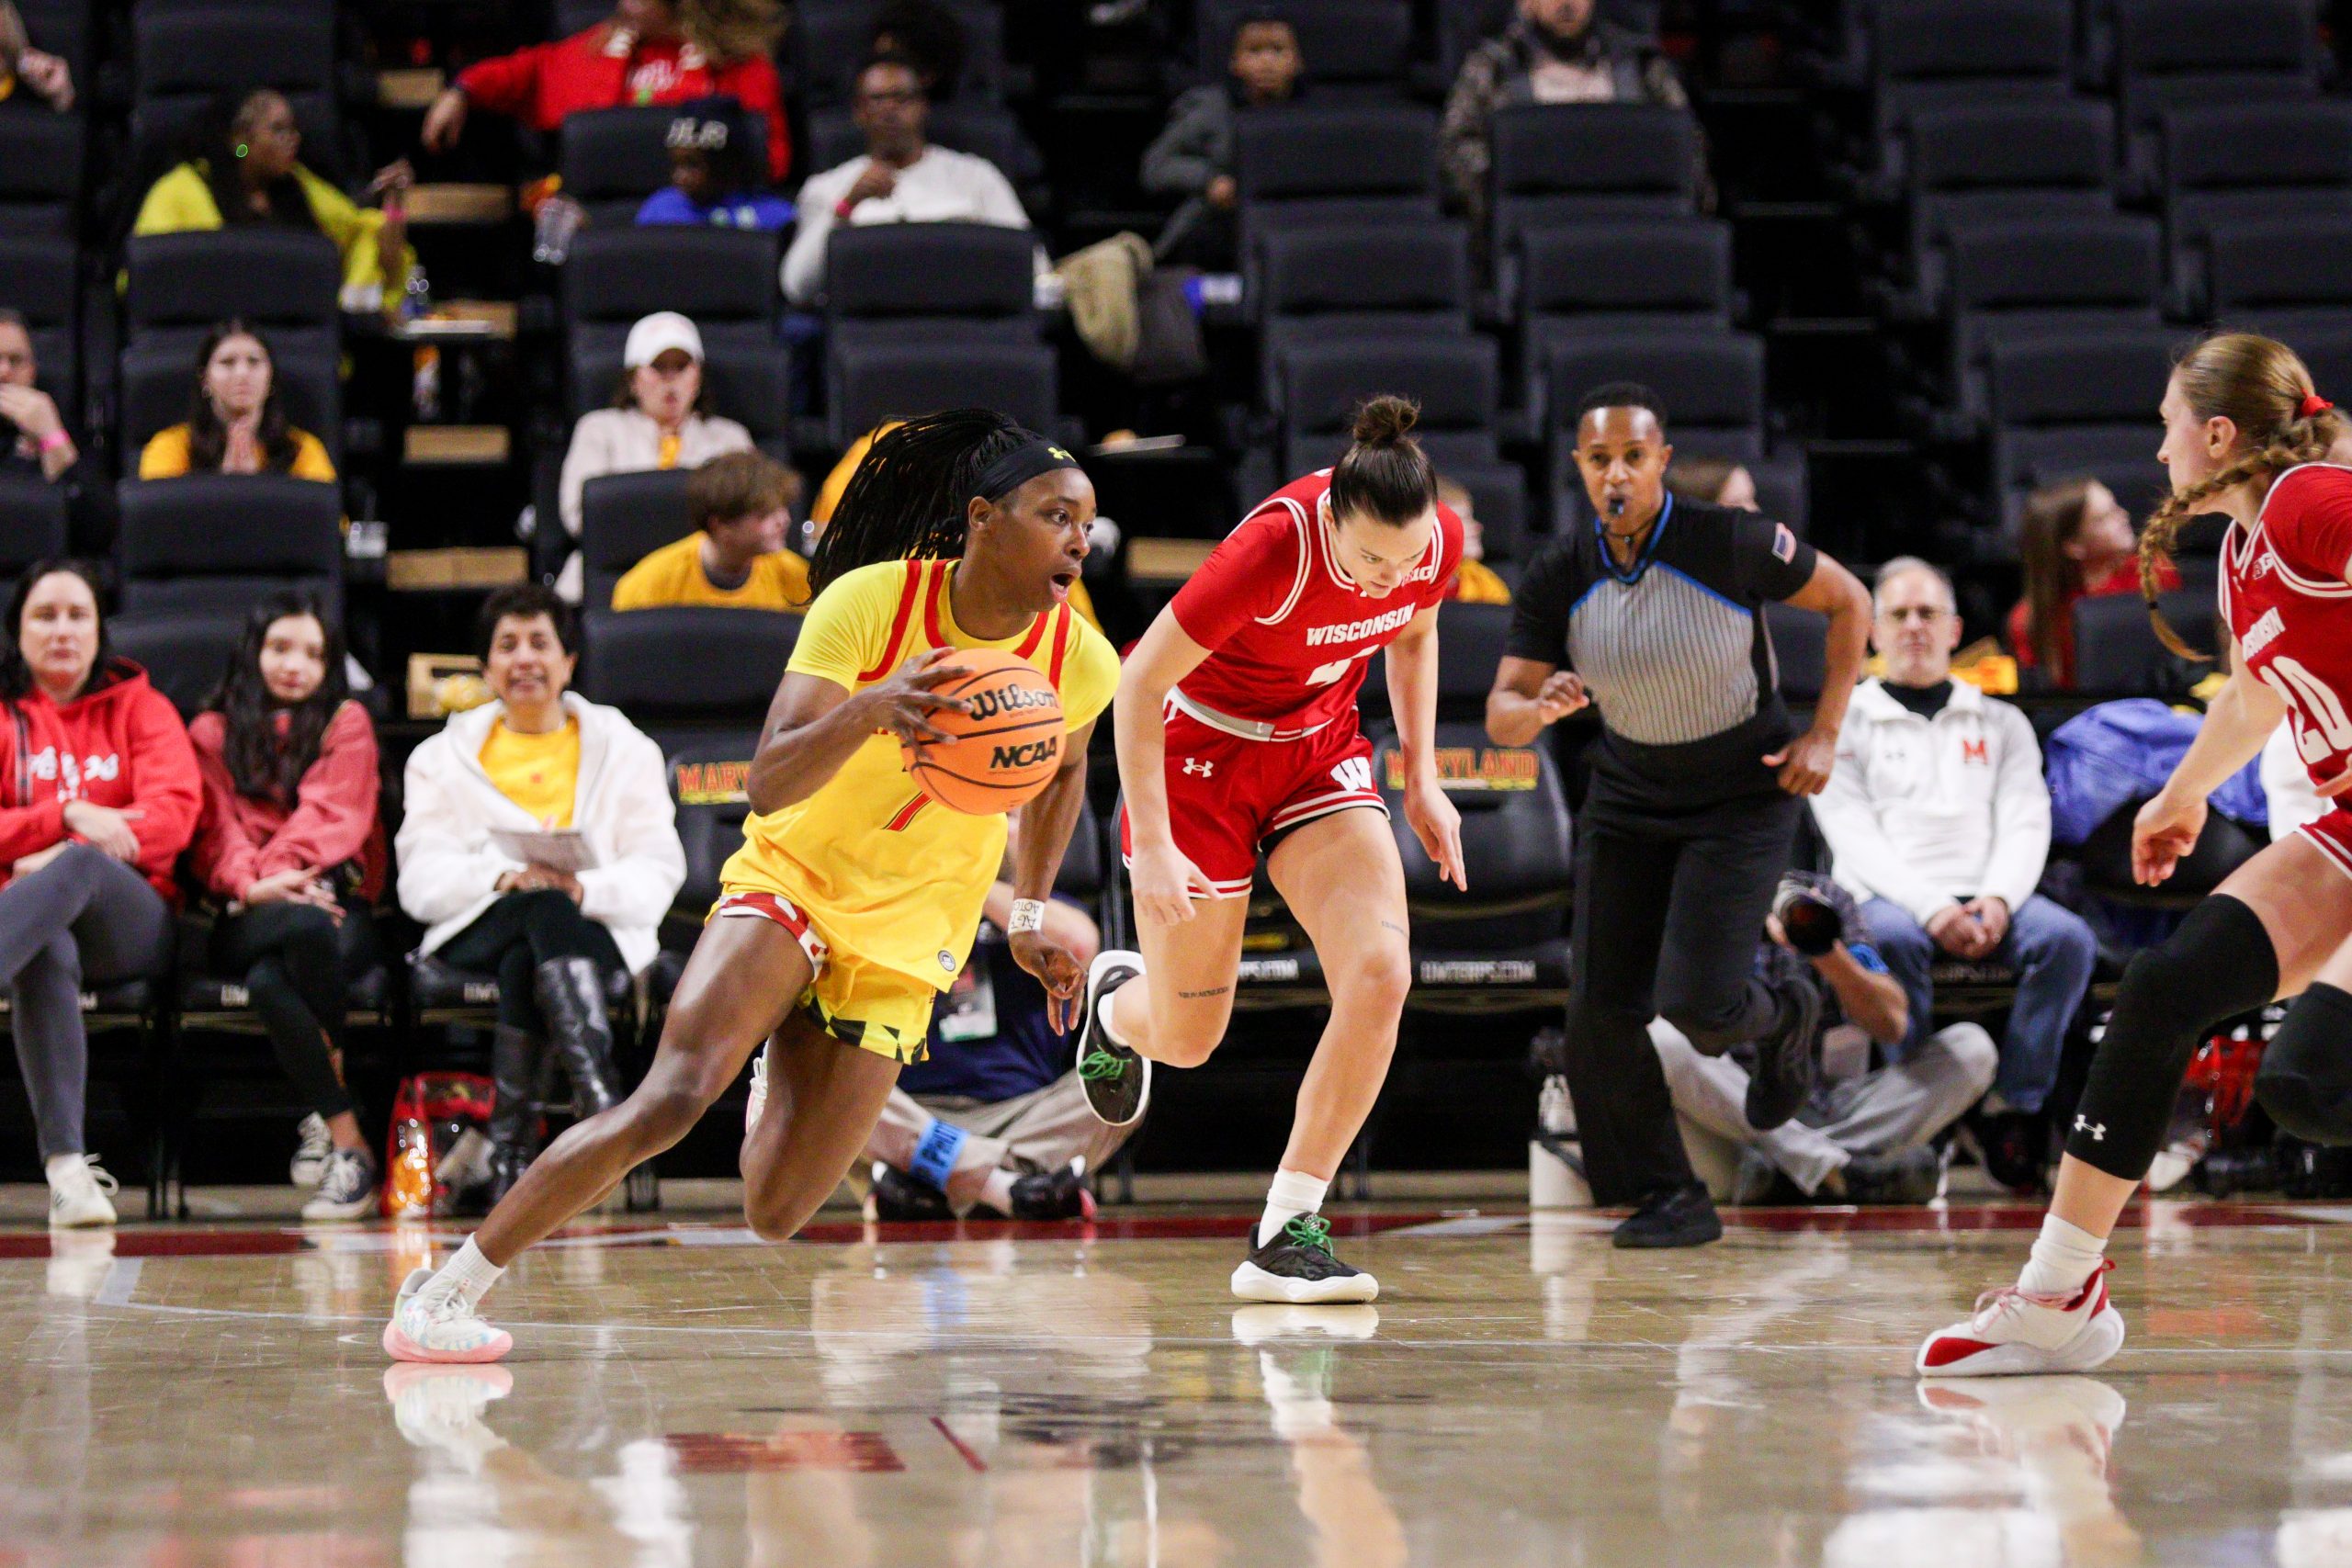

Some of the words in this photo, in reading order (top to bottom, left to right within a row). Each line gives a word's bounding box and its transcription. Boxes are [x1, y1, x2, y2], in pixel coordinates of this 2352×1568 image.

[1306, 602, 1417, 647] WISCONSIN
[966, 683, 1057, 721] Wilson
[989, 736, 1057, 770] NCAA
[1329, 756, 1373, 793] W
